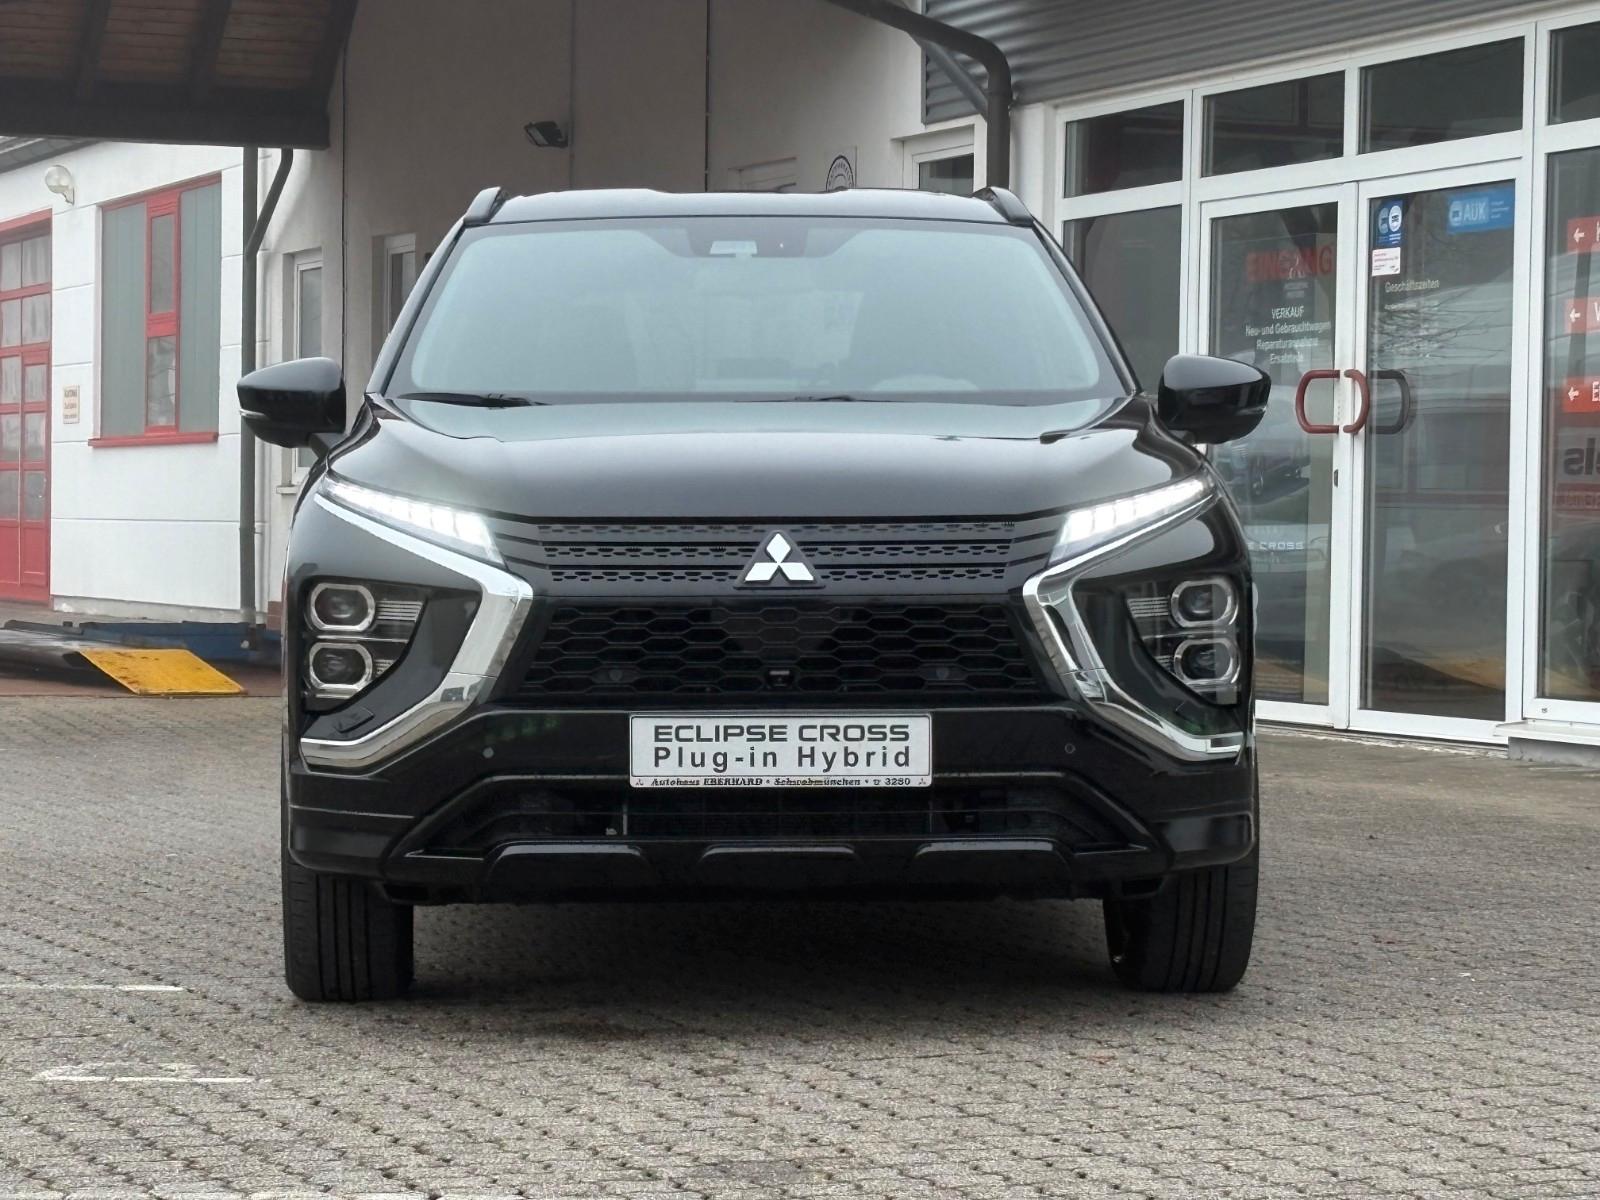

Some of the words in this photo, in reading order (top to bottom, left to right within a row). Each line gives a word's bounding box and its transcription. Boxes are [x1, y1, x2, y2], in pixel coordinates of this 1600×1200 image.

[1271, 305, 1305, 319] VERKAUF
[1259, 541, 1305, 550] CROSS
[653, 724, 788, 743] ECLIPSE
[798, 724, 910, 742] CROSS
[654, 746, 778, 773] Plug-in
[797, 745, 910, 773] Hybrid
[651, 777, 700, 787] Autohaus
[703, 777, 763, 786] EBERHARD
